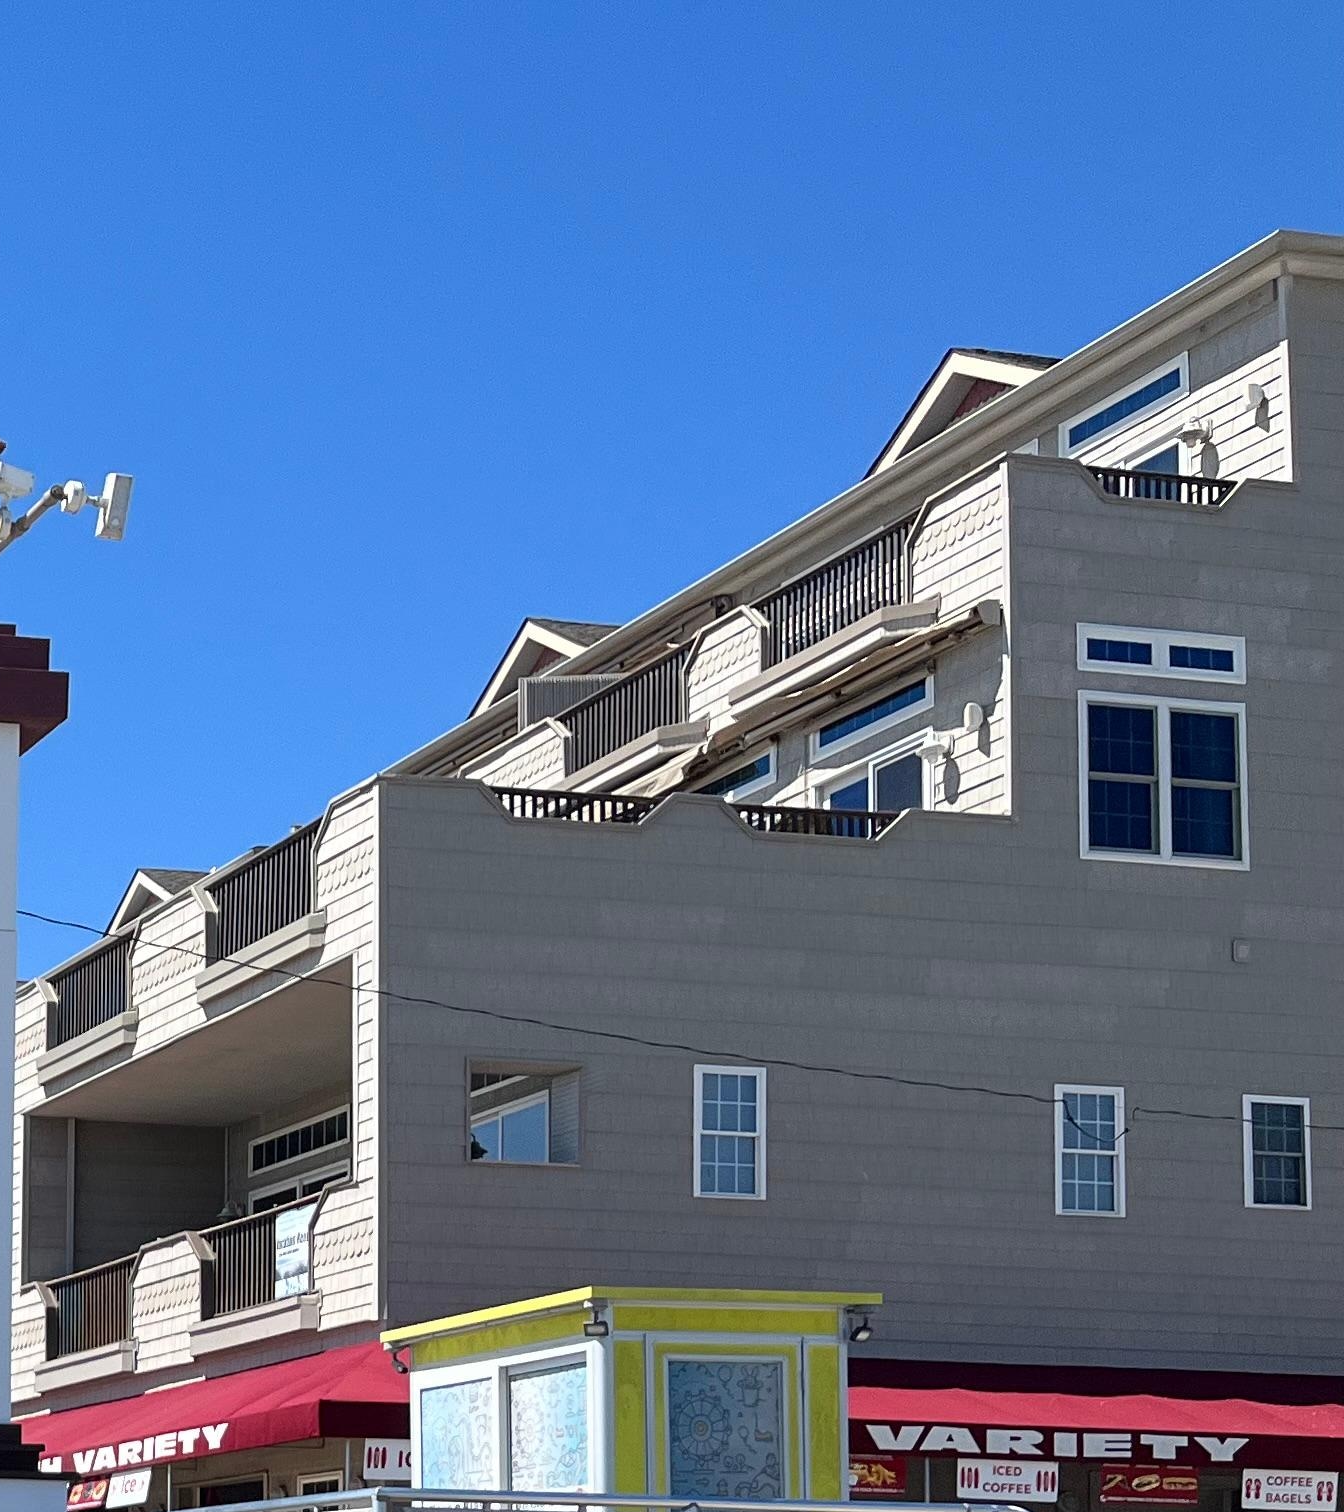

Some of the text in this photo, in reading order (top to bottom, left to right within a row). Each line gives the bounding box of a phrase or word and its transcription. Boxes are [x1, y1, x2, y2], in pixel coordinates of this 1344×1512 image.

[73, 1422, 229, 1475] VARIETY
[865, 1424, 1250, 1462] VARIETY
[992, 1465, 1022, 1477] ICED
[1266, 1475, 1313, 1488] COFFEE
[982, 1482, 1031, 1494] COFFEE
[1265, 1492, 1312, 1504] BAGELS
